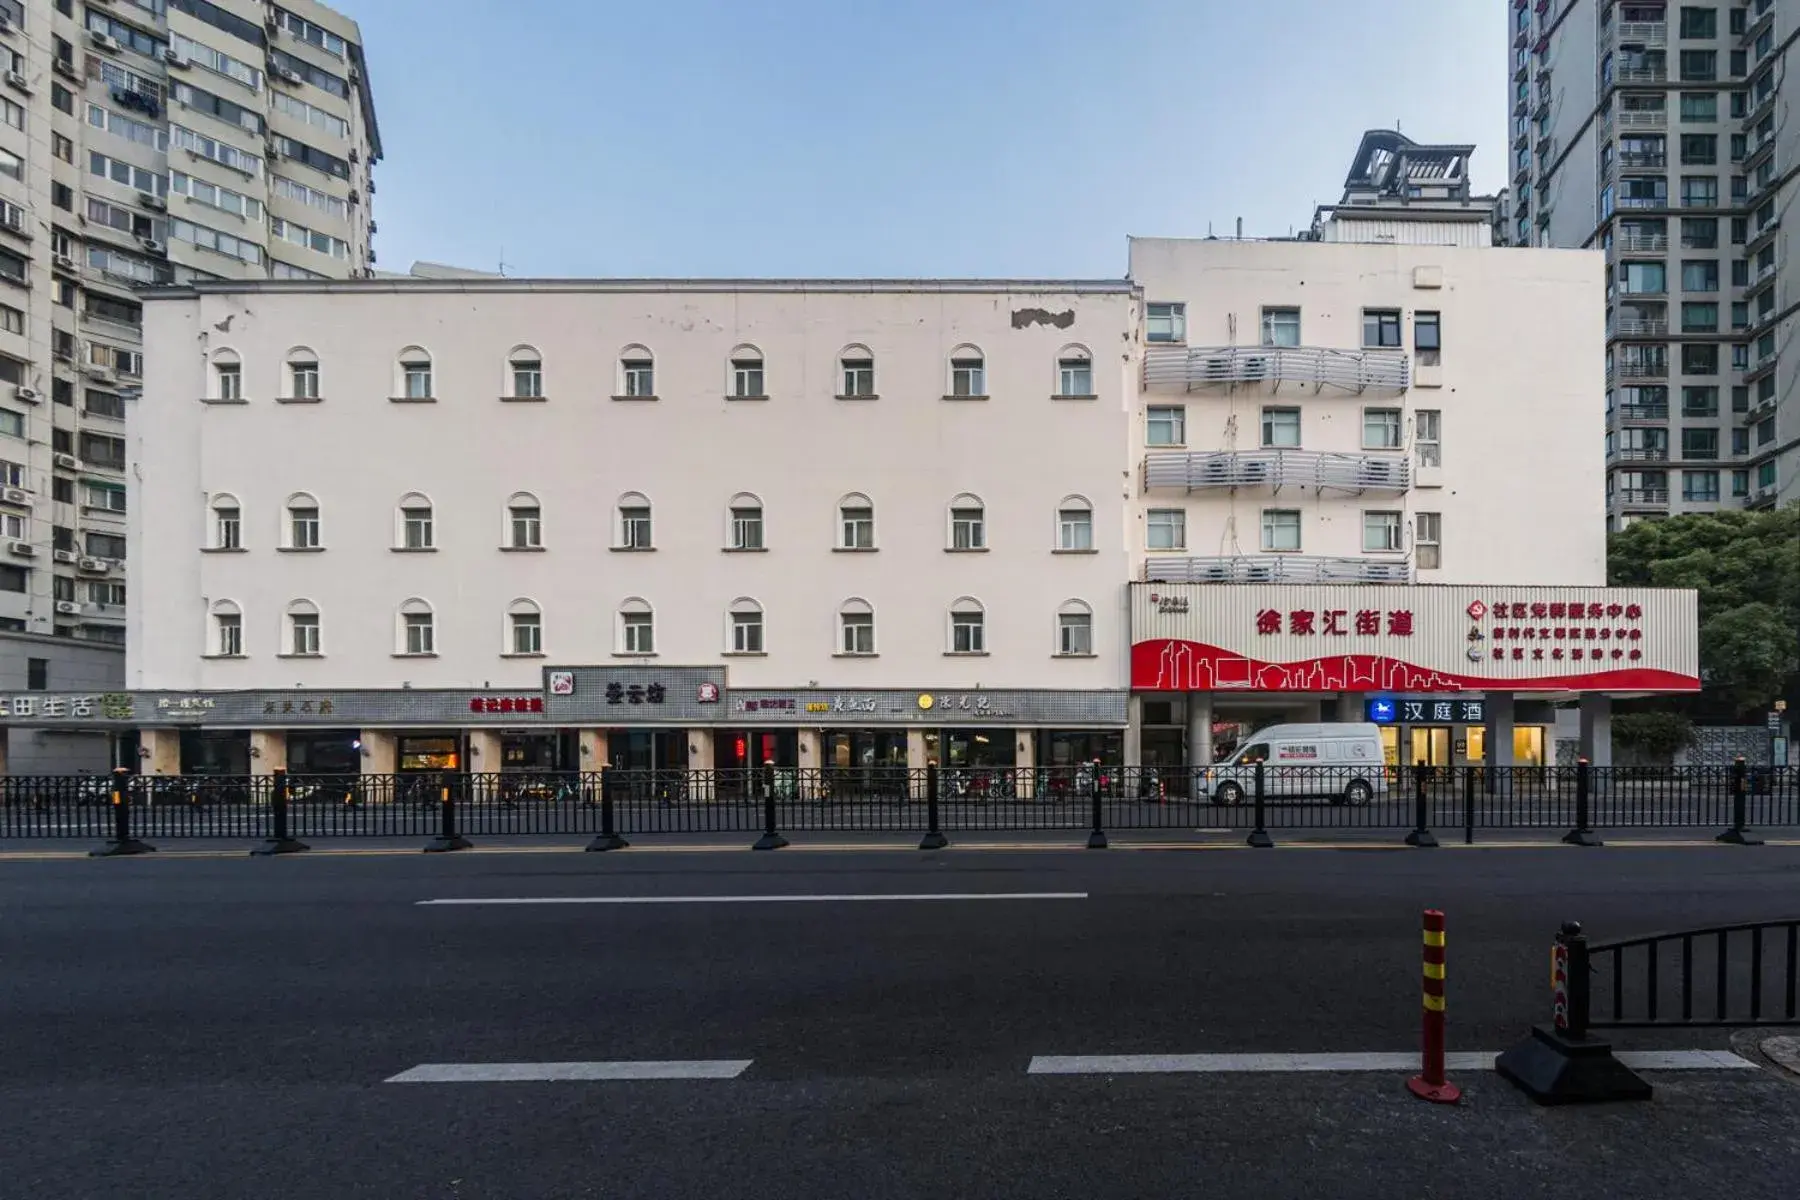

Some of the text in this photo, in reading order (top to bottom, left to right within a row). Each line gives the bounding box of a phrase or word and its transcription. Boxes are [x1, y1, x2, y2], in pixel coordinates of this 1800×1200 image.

[1256, 608, 1414, 636] 徐家汇街道
[1404, 702, 1482, 721] 汉庭酒
